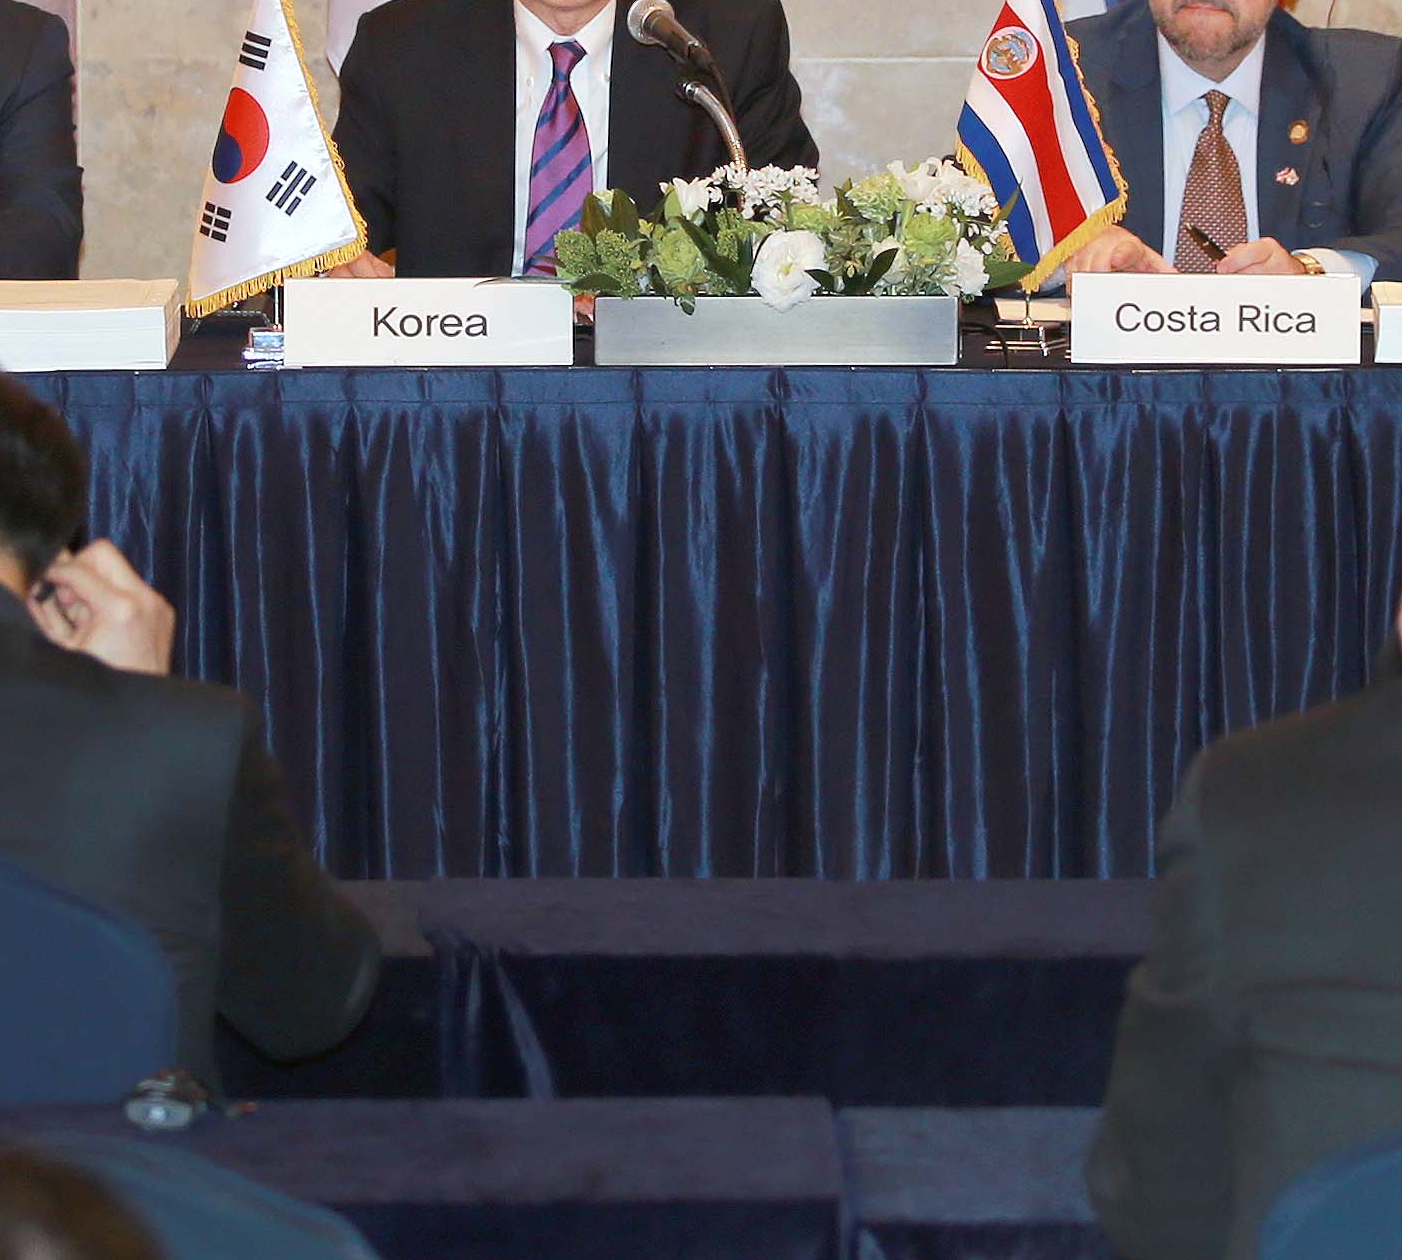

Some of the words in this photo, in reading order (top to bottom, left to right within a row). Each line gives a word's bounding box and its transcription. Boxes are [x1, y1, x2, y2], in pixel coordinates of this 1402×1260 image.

[373, 306, 488, 338] Korea
[1114, 302, 1221, 334] Costa
[1238, 303, 1317, 335] Rica
